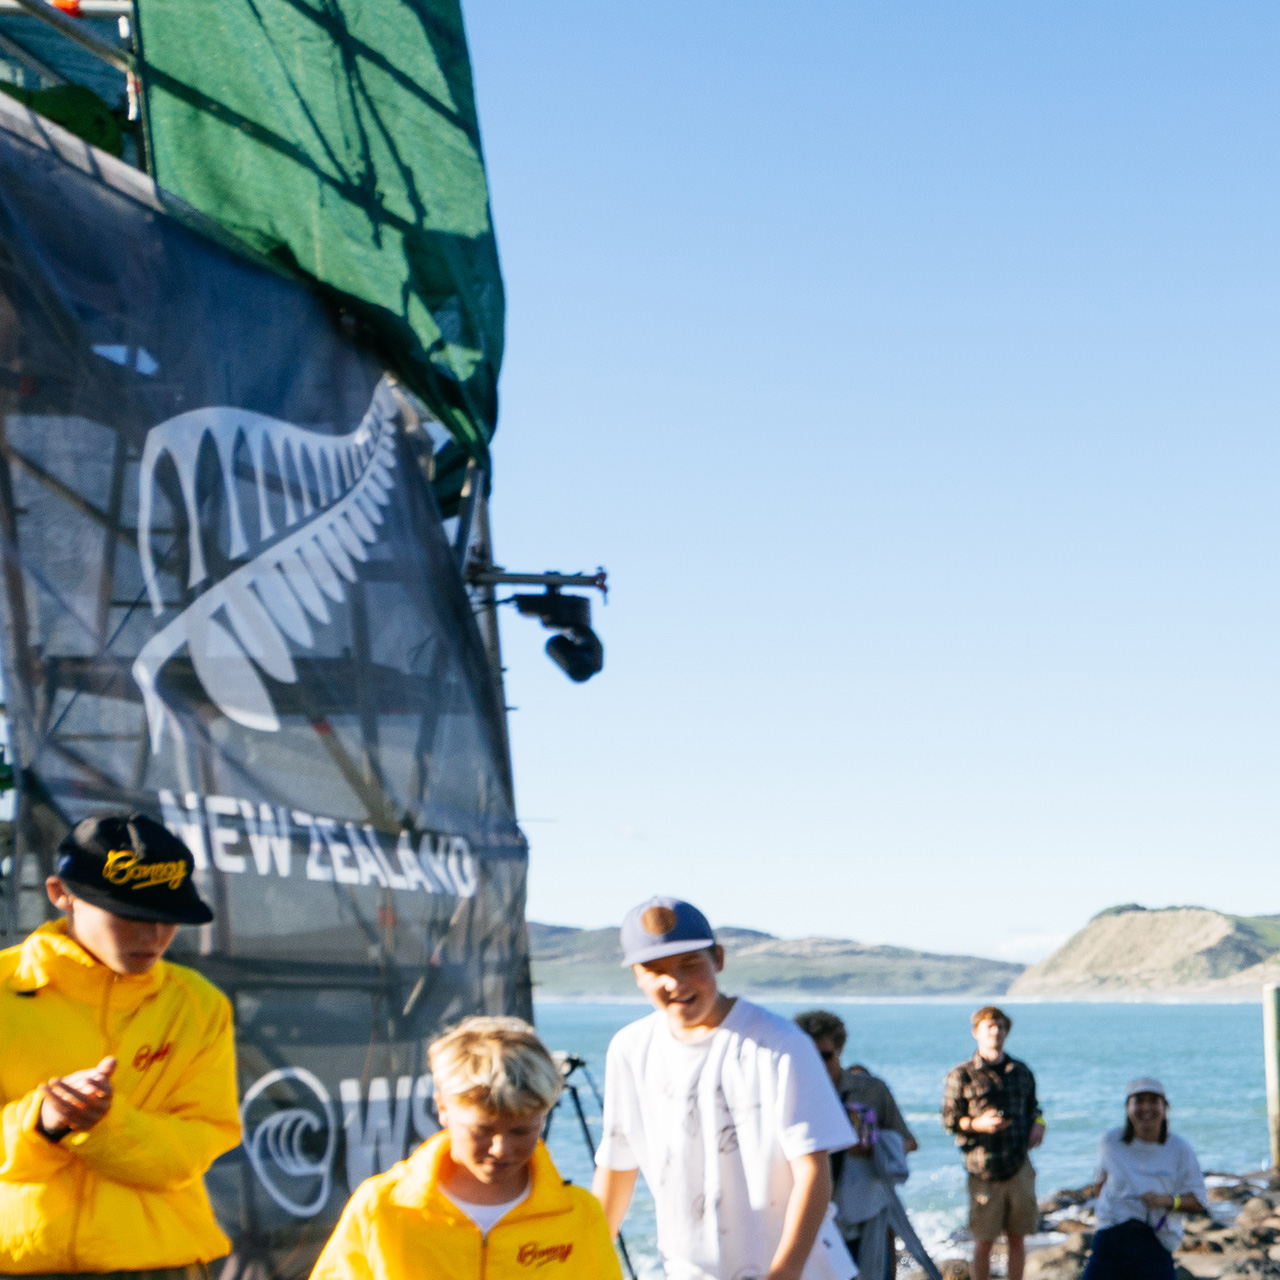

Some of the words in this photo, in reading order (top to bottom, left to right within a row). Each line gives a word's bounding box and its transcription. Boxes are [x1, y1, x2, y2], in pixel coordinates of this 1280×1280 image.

[159, 789, 293, 880] NEW
[293, 812, 482, 899] ZEALAND
[339, 1073, 441, 1196] WS
